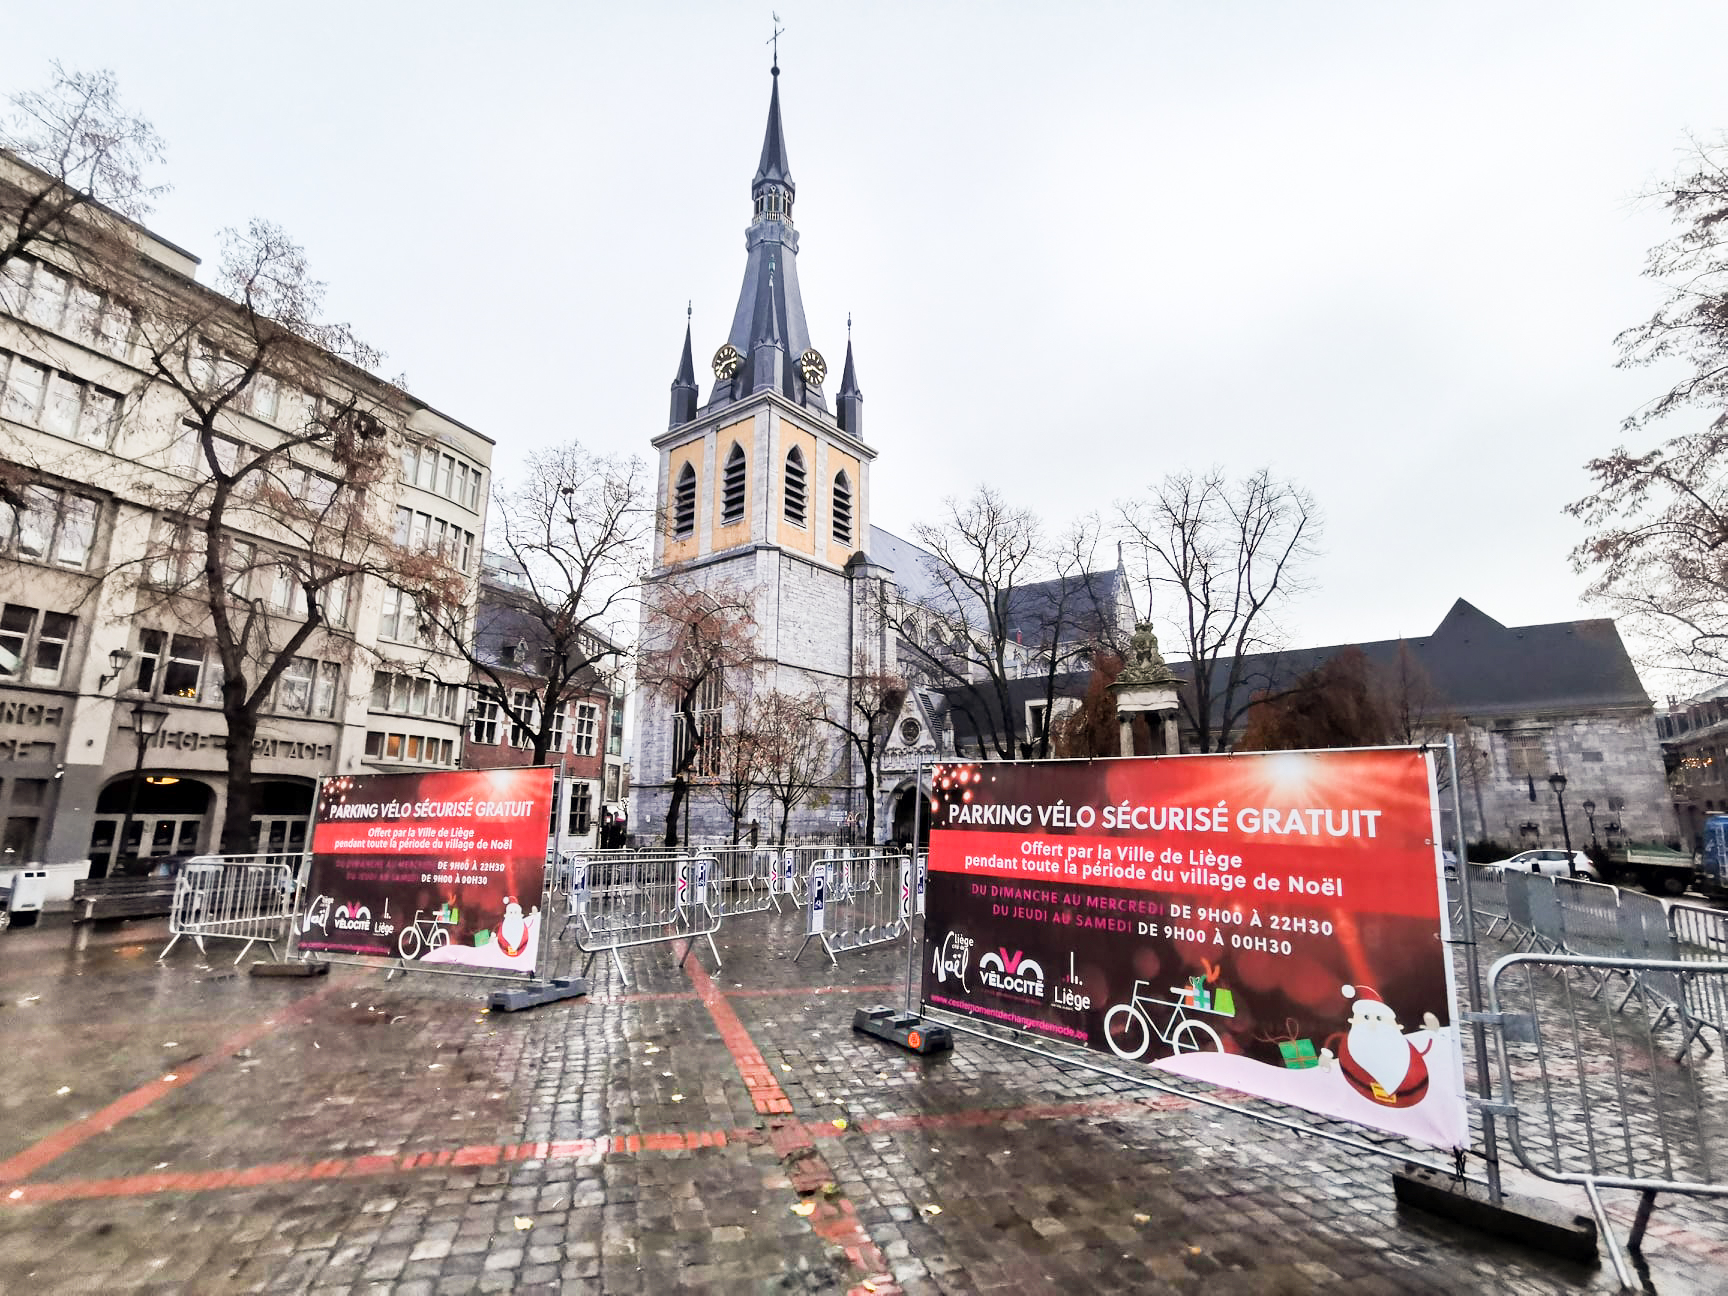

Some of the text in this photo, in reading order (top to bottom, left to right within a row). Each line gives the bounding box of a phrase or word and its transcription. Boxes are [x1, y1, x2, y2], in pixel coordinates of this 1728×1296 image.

[329, 797, 534, 818] PARKING VÉLO SÉCURISÉ GRATUIT
[949, 799, 1382, 838] PARKING VÉLO SÉCURISÉ GRATUIT
[334, 838, 513, 851] pendant toute la période du village de Noël
[368, 827, 474, 840] Offert par la Ville de Liège
[437, 861, 448, 870] DE
[450, 861, 469, 871] 9H00
[472, 860, 478, 871] À
[480, 862, 505, 872] 22H30
[1021, 841, 1242, 871] Offert par la Ville de Liège
[421, 873, 432, 883] DE
[433, 874, 453, 884] 9H00
[454, 873, 460, 884] À
[461, 875, 487, 885] 00H30
[965, 854, 1343, 897] pendant toute la période du village de Noël
[815, 877, 824, 898] P
[972, 883, 1333, 936] DU DIMANCHE AU MERCREDI DE 9H00 À 22H30
[374, 921, 395, 936] Liège
[993, 903, 1292, 955] DU JEUDI AU SAMEDI DE 9H00 À 00H30
[932, 930, 971, 993] Noël
[1054, 986, 1091, 1011] Liège
